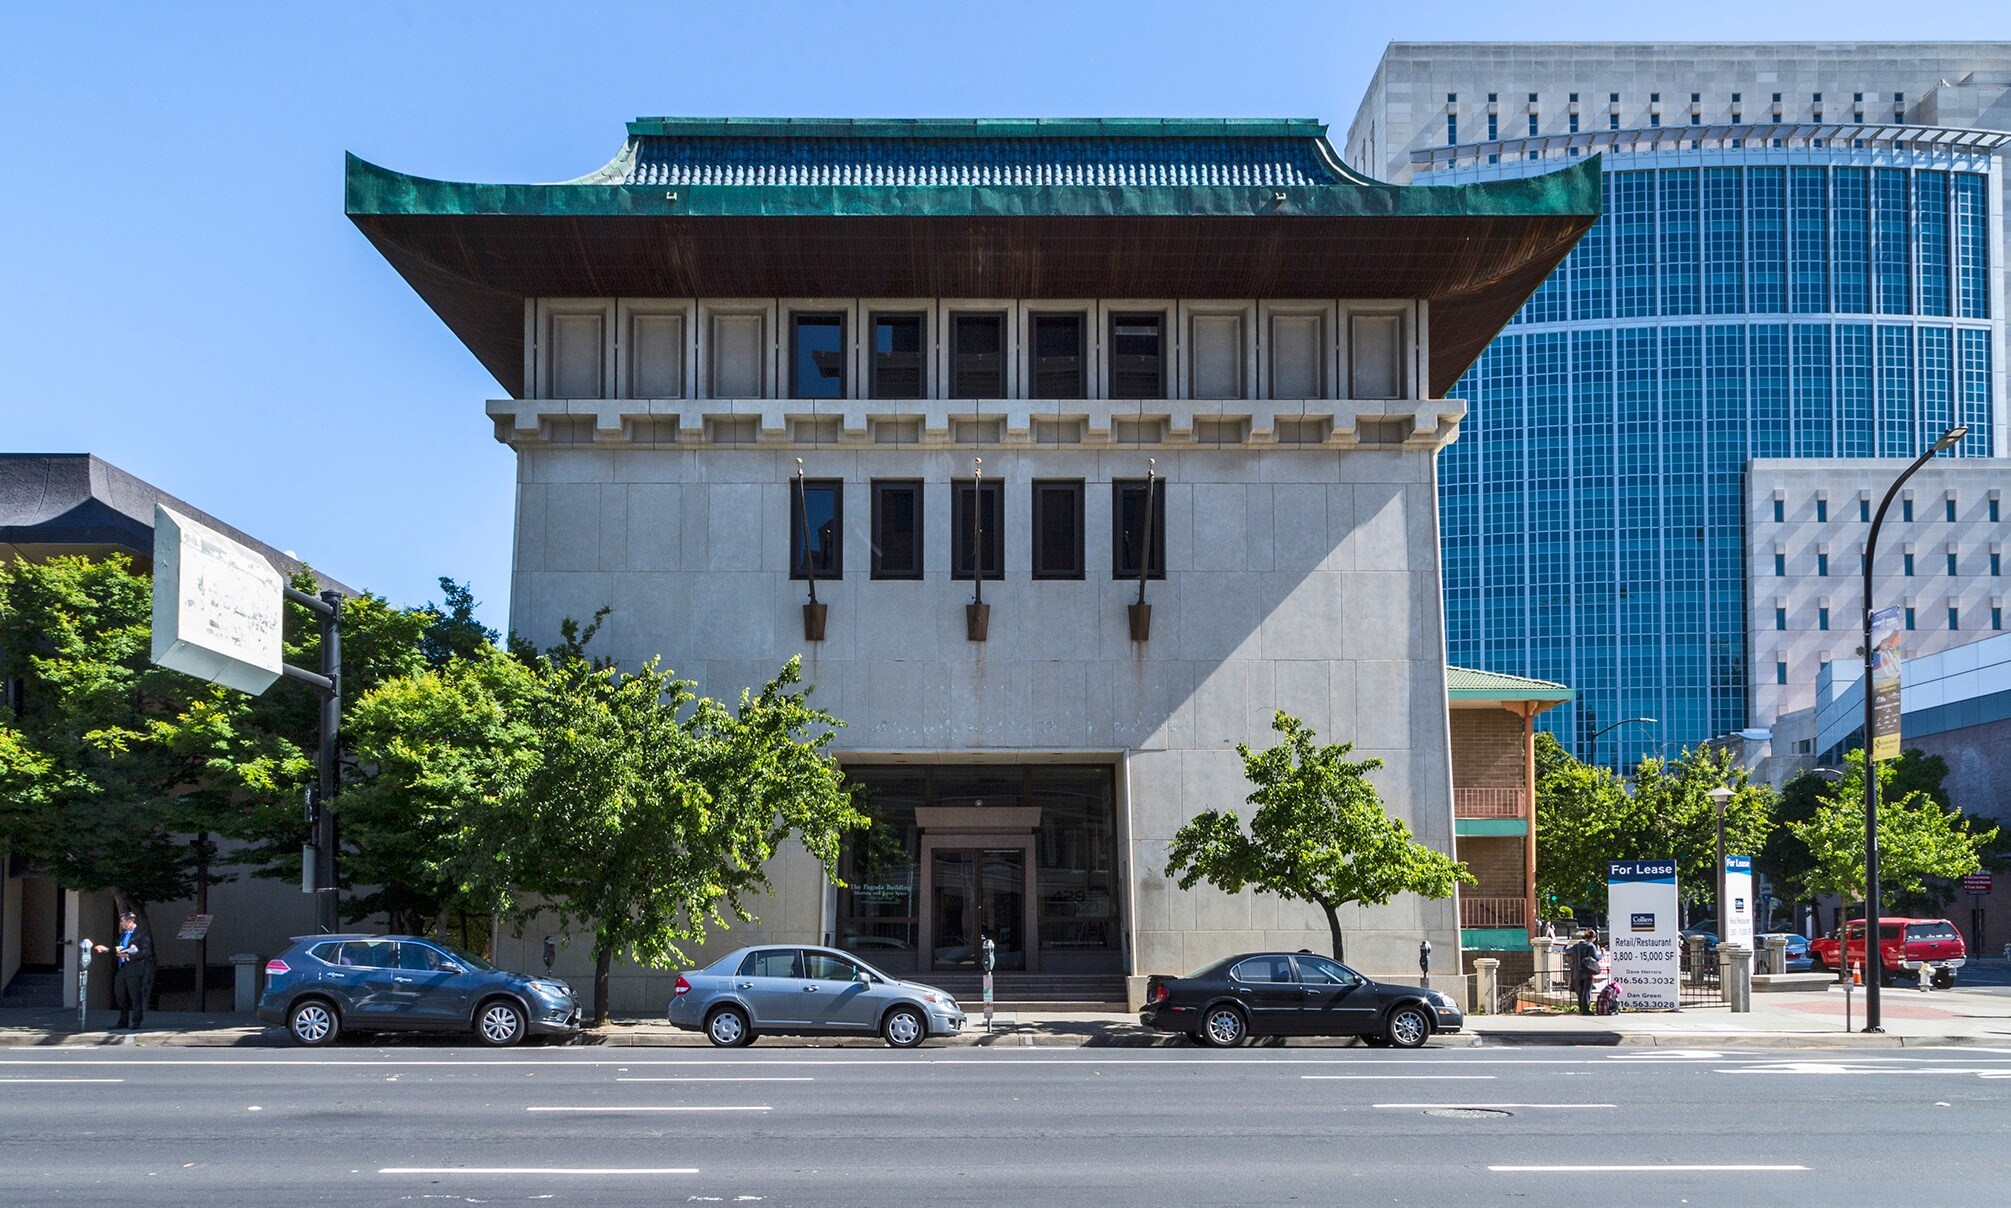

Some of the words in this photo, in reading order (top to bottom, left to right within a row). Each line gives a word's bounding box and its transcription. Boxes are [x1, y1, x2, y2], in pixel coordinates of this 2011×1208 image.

[1726, 858, 1735, 867] For
[1736, 859, 1750, 867] Lease
[1611, 865, 1632, 875] For
[1636, 865, 1673, 875] Lease
[1615, 937, 1672, 947] Retail/Restaurant
[1613, 951, 1633, 962] 3,800
[1640, 951, 1663, 962] 15,000
[1664, 951, 1674, 961] SF
[1613, 976, 1675, 985] 916.563.3032
